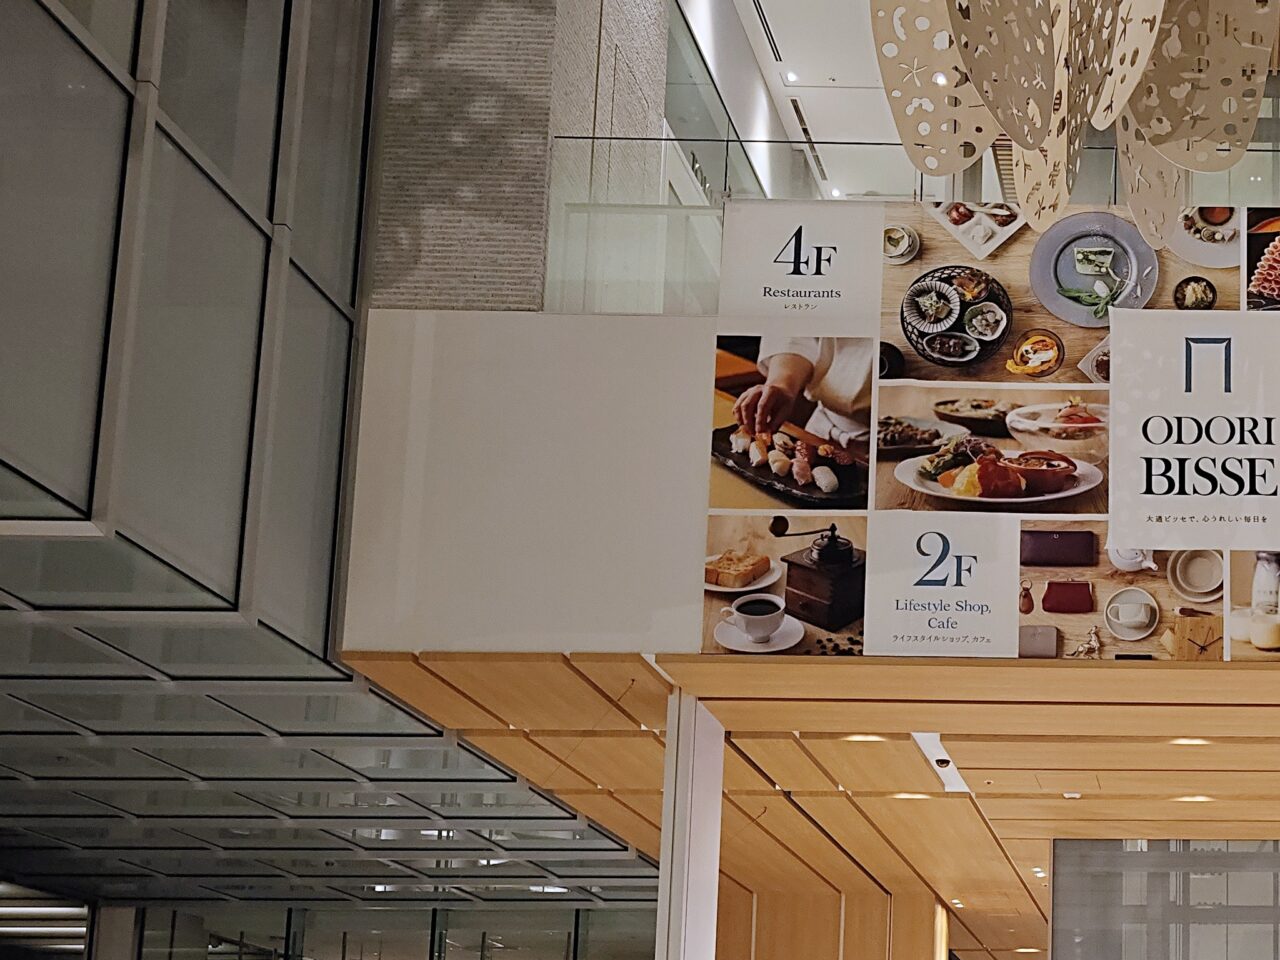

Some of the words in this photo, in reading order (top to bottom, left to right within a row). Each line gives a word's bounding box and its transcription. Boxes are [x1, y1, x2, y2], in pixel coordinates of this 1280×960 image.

[773, 225, 837, 276] 4F
[763, 287, 841, 298] Restaurants
[1142, 415, 1276, 446] ODORI
[1139, 456, 1278, 497] BISSE
[913, 531, 978, 587] 2F
[895, 599, 951, 614] Lifestyle
[955, 599, 991, 615] Shop,
[928, 617, 958, 629] Cafe
